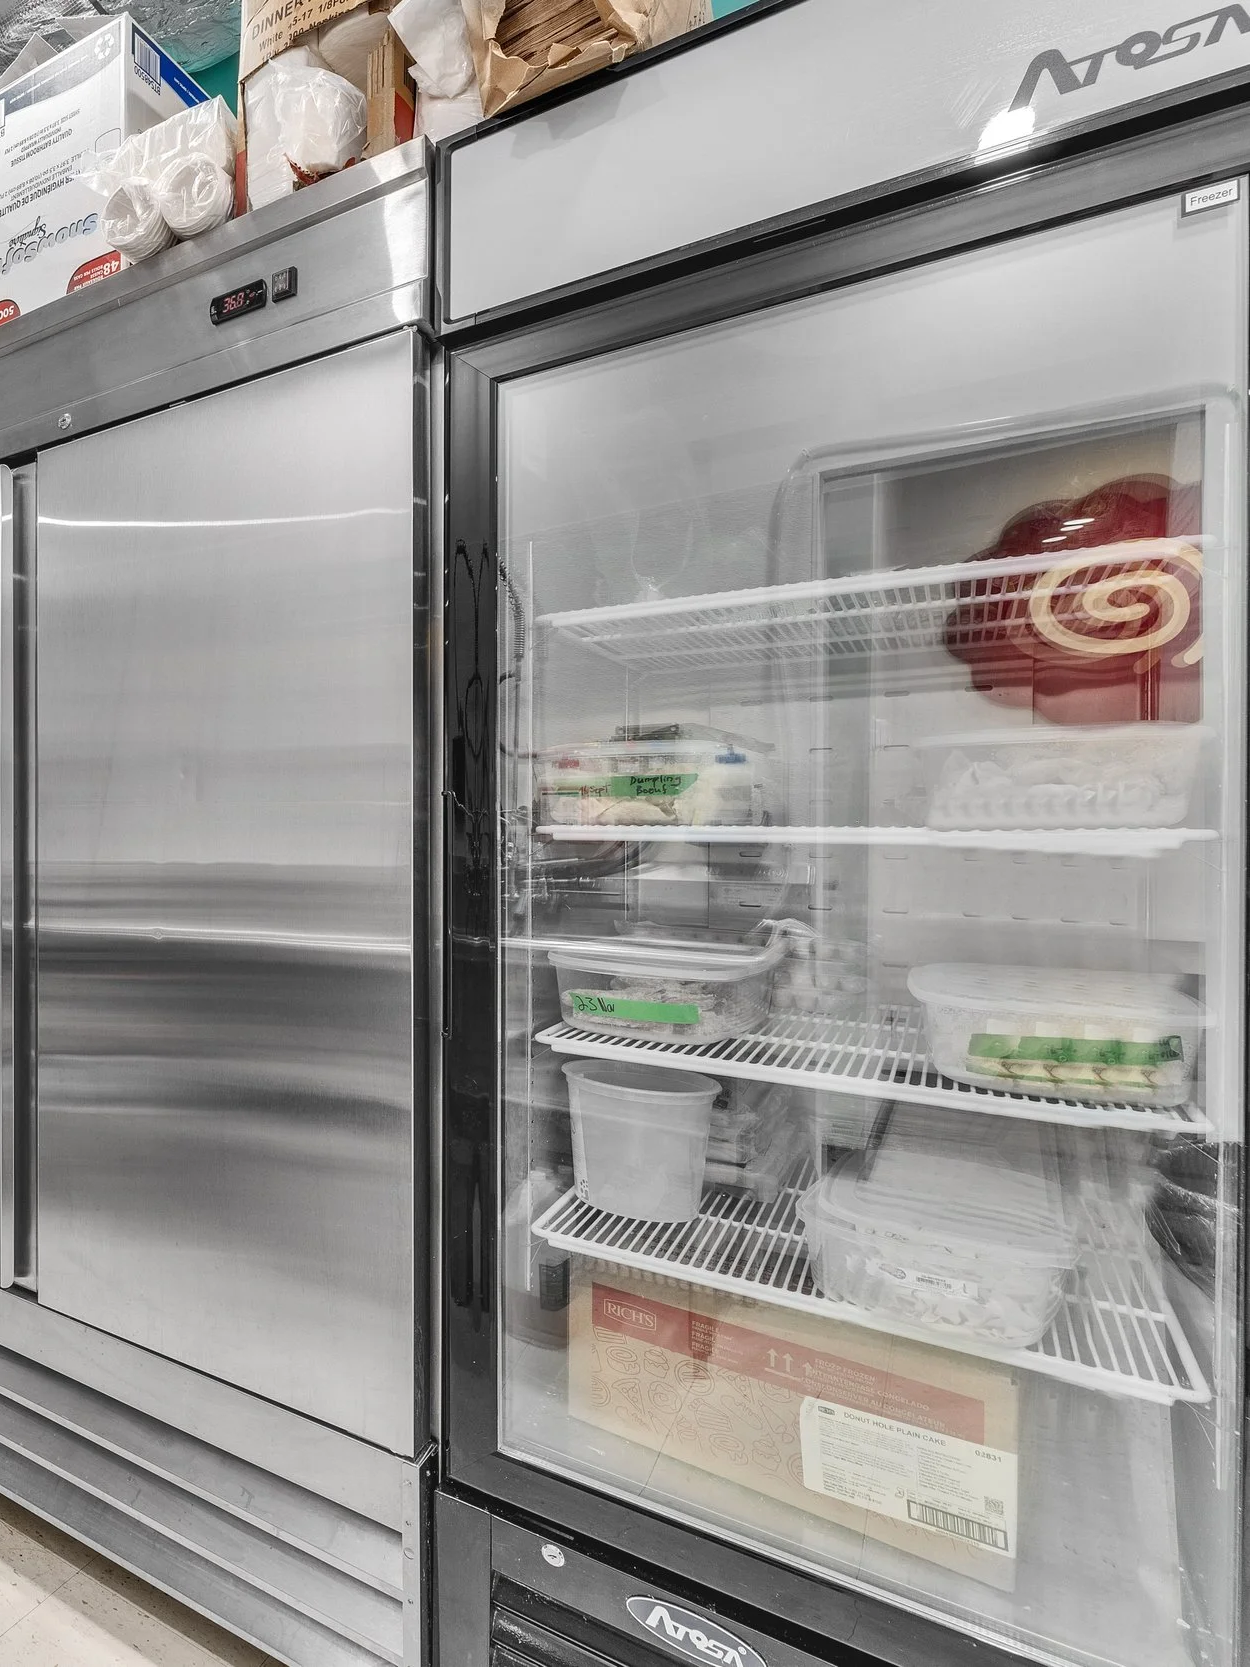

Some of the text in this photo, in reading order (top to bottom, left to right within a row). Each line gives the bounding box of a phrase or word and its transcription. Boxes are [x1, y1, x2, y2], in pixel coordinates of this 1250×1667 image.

[1190, 187, 1233, 207] Freezer
[103, 260, 120, 275] 48
[576, 995, 598, 1012] 23
[607, 1302, 655, 1329] RICH'S
[843, 1411, 947, 1447] DONUT HOLE PLAIN CAKE
[974, 1449, 1002, 1463] 02831
